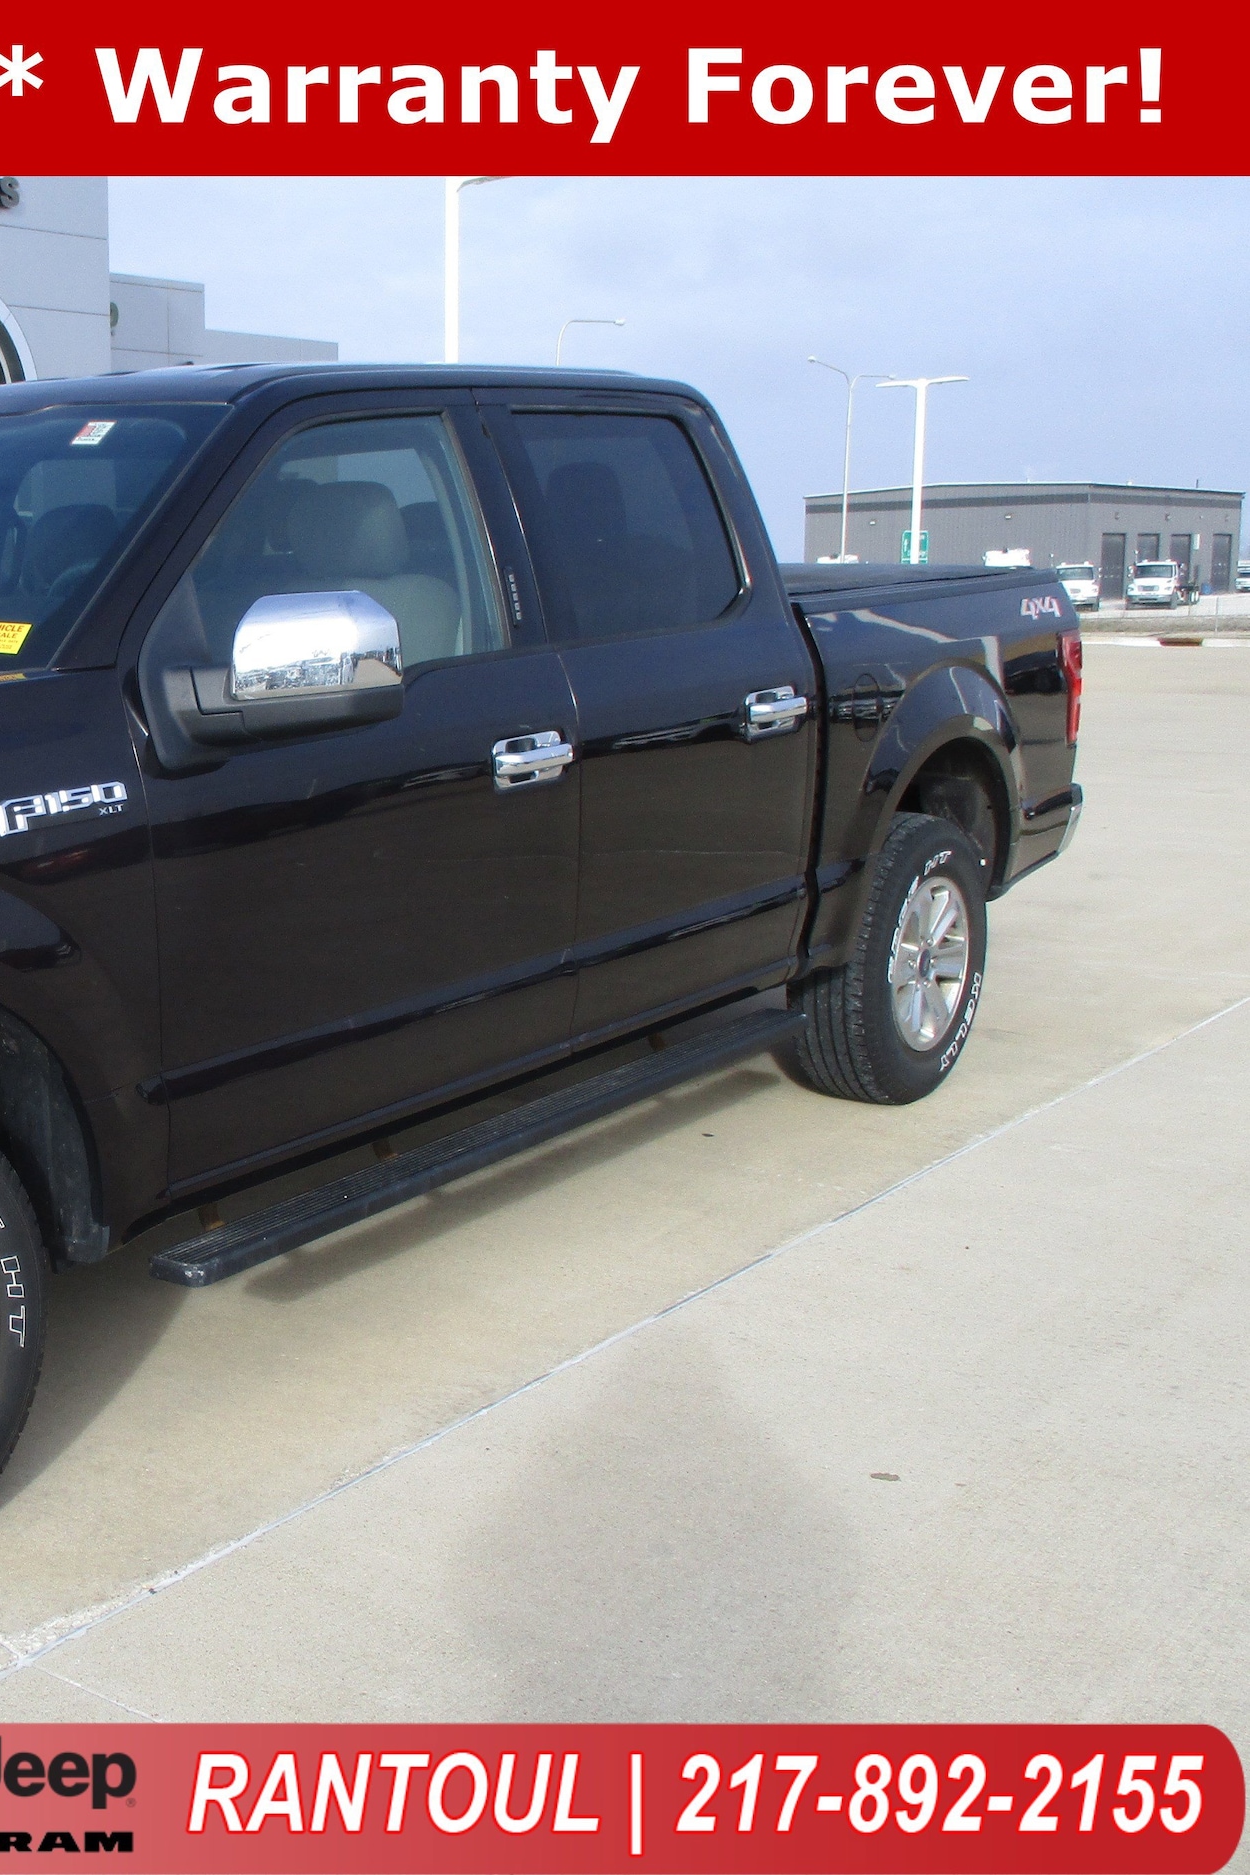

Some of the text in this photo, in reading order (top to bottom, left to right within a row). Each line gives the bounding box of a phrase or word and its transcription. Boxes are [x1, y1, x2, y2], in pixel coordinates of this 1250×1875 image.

[99, 803, 124, 816] XLT
[938, 971, 983, 1072] KELLY
[0, 1255, 27, 1349] HT
